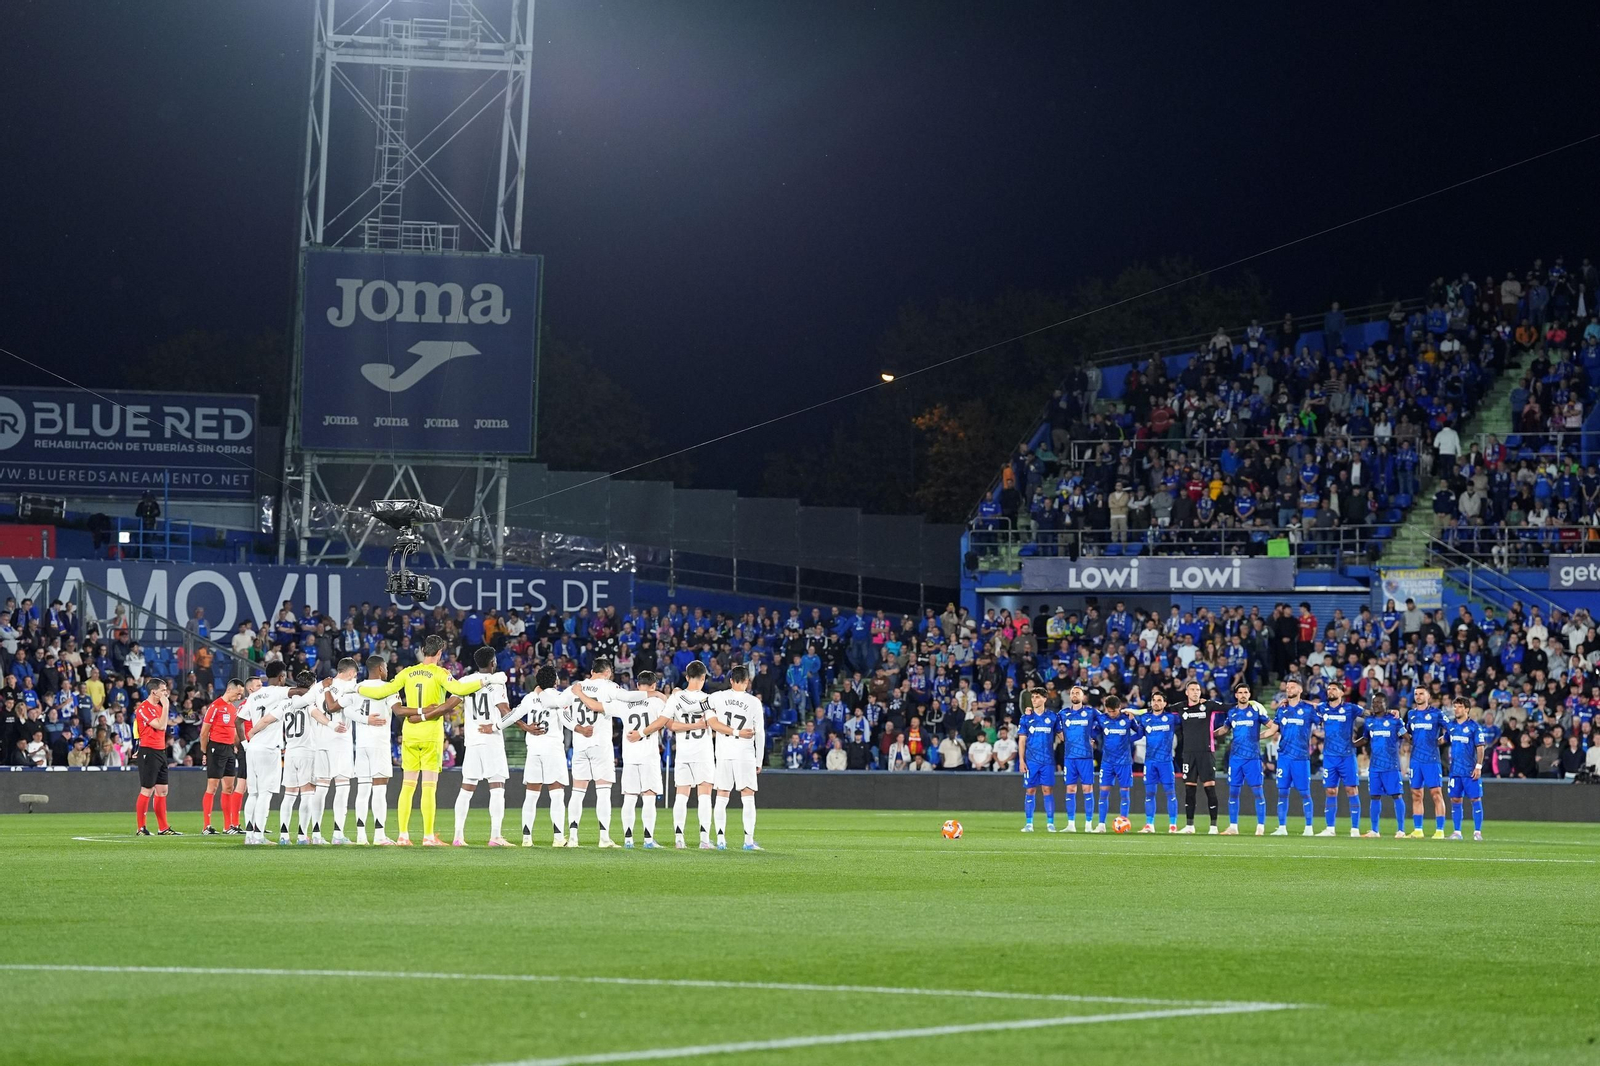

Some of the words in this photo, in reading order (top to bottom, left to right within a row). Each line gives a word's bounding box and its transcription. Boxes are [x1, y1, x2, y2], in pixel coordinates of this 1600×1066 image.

[33, 401, 151, 437] BLUE
[163, 406, 253, 440] RED
[34, 440, 123, 451] REHABILITACIÓN
[125, 442, 140, 451] DE
[142, 442, 194, 453] TUBERÍAS
[196, 444, 214, 453] SIN
[216, 445, 253, 454] OBRAS
[1560, 563, 1600, 587] get
[562, 579, 609, 612] DE
[415, 683, 423, 708] 1
[469, 692, 490, 720] 14
[724, 699, 744, 708] LUCAS
[285, 710, 305, 738] 20
[574, 696, 598, 725] 35
[628, 712, 650, 740] 21
[681, 713, 705, 739] 15
[724, 711, 747, 739] 17
